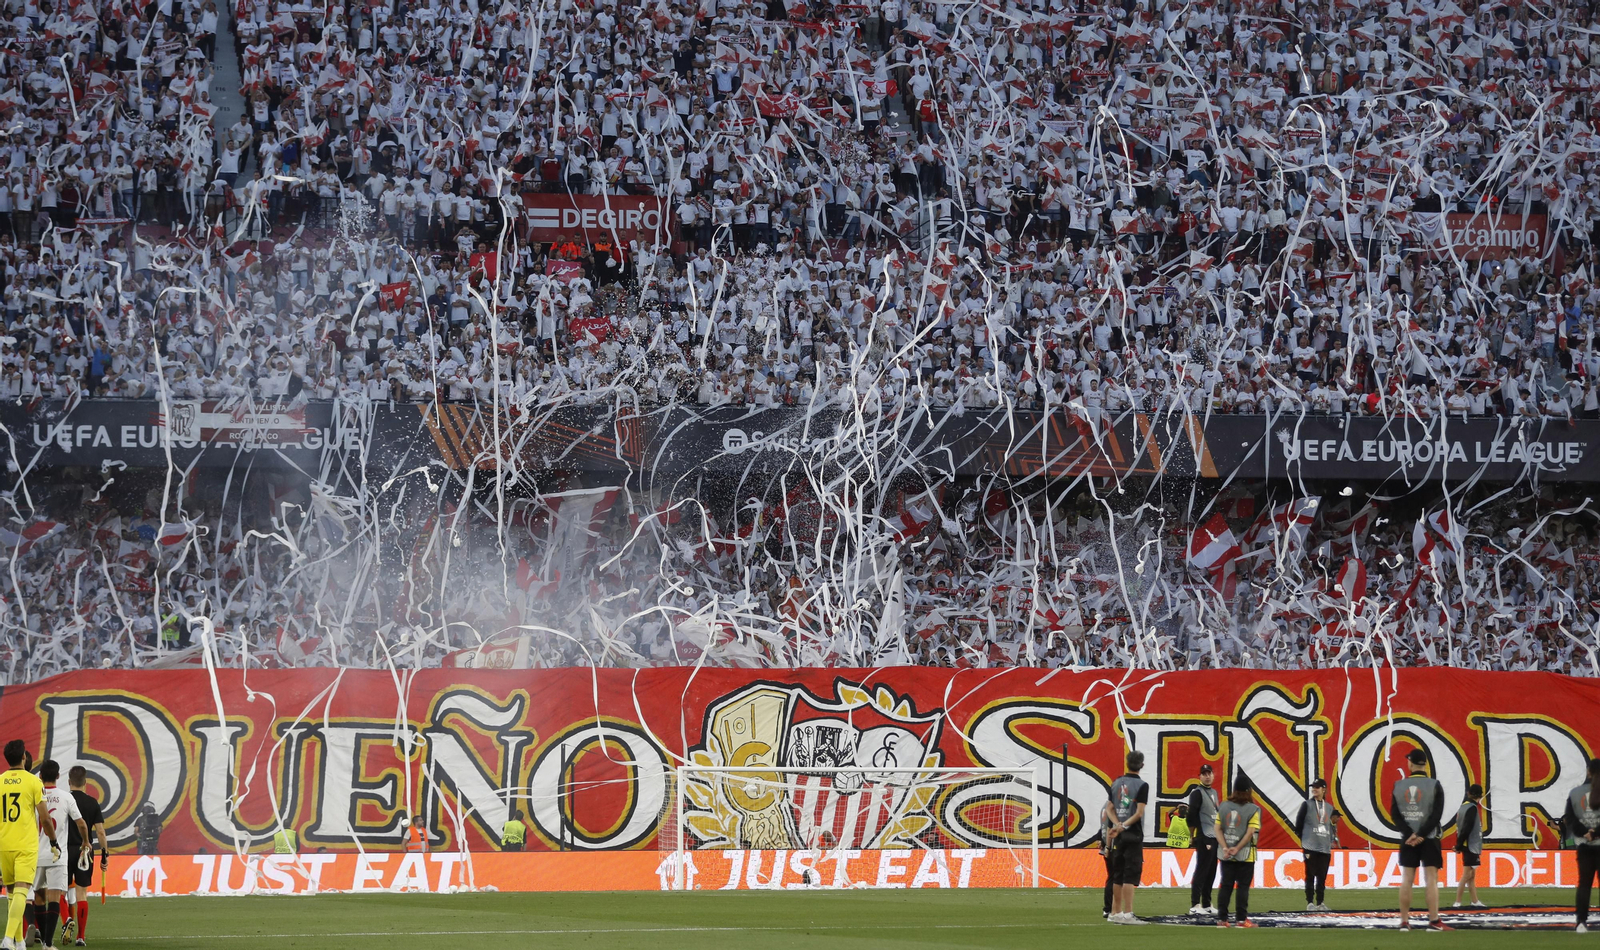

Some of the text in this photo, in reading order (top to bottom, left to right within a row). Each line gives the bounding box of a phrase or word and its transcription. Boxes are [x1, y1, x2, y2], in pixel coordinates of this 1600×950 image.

[28, 121, 39, 129] Lee
[562, 207, 662, 230] DEGIRO
[1438, 227, 1540, 250] uzcampo
[33, 424, 112, 448] UEFA
[1283, 439, 1580, 464] UEFA EUROPA LEAGUE
[36, 681, 1598, 850] DUEÑO SEÑOR
[4, 777, 22, 785] BONO
[2, 792, 21, 823] 13
[190, 852, 467, 894] JUST EAT
[714, 849, 986, 890] JUST EAT
[1489, 851, 1577, 888] DEL
